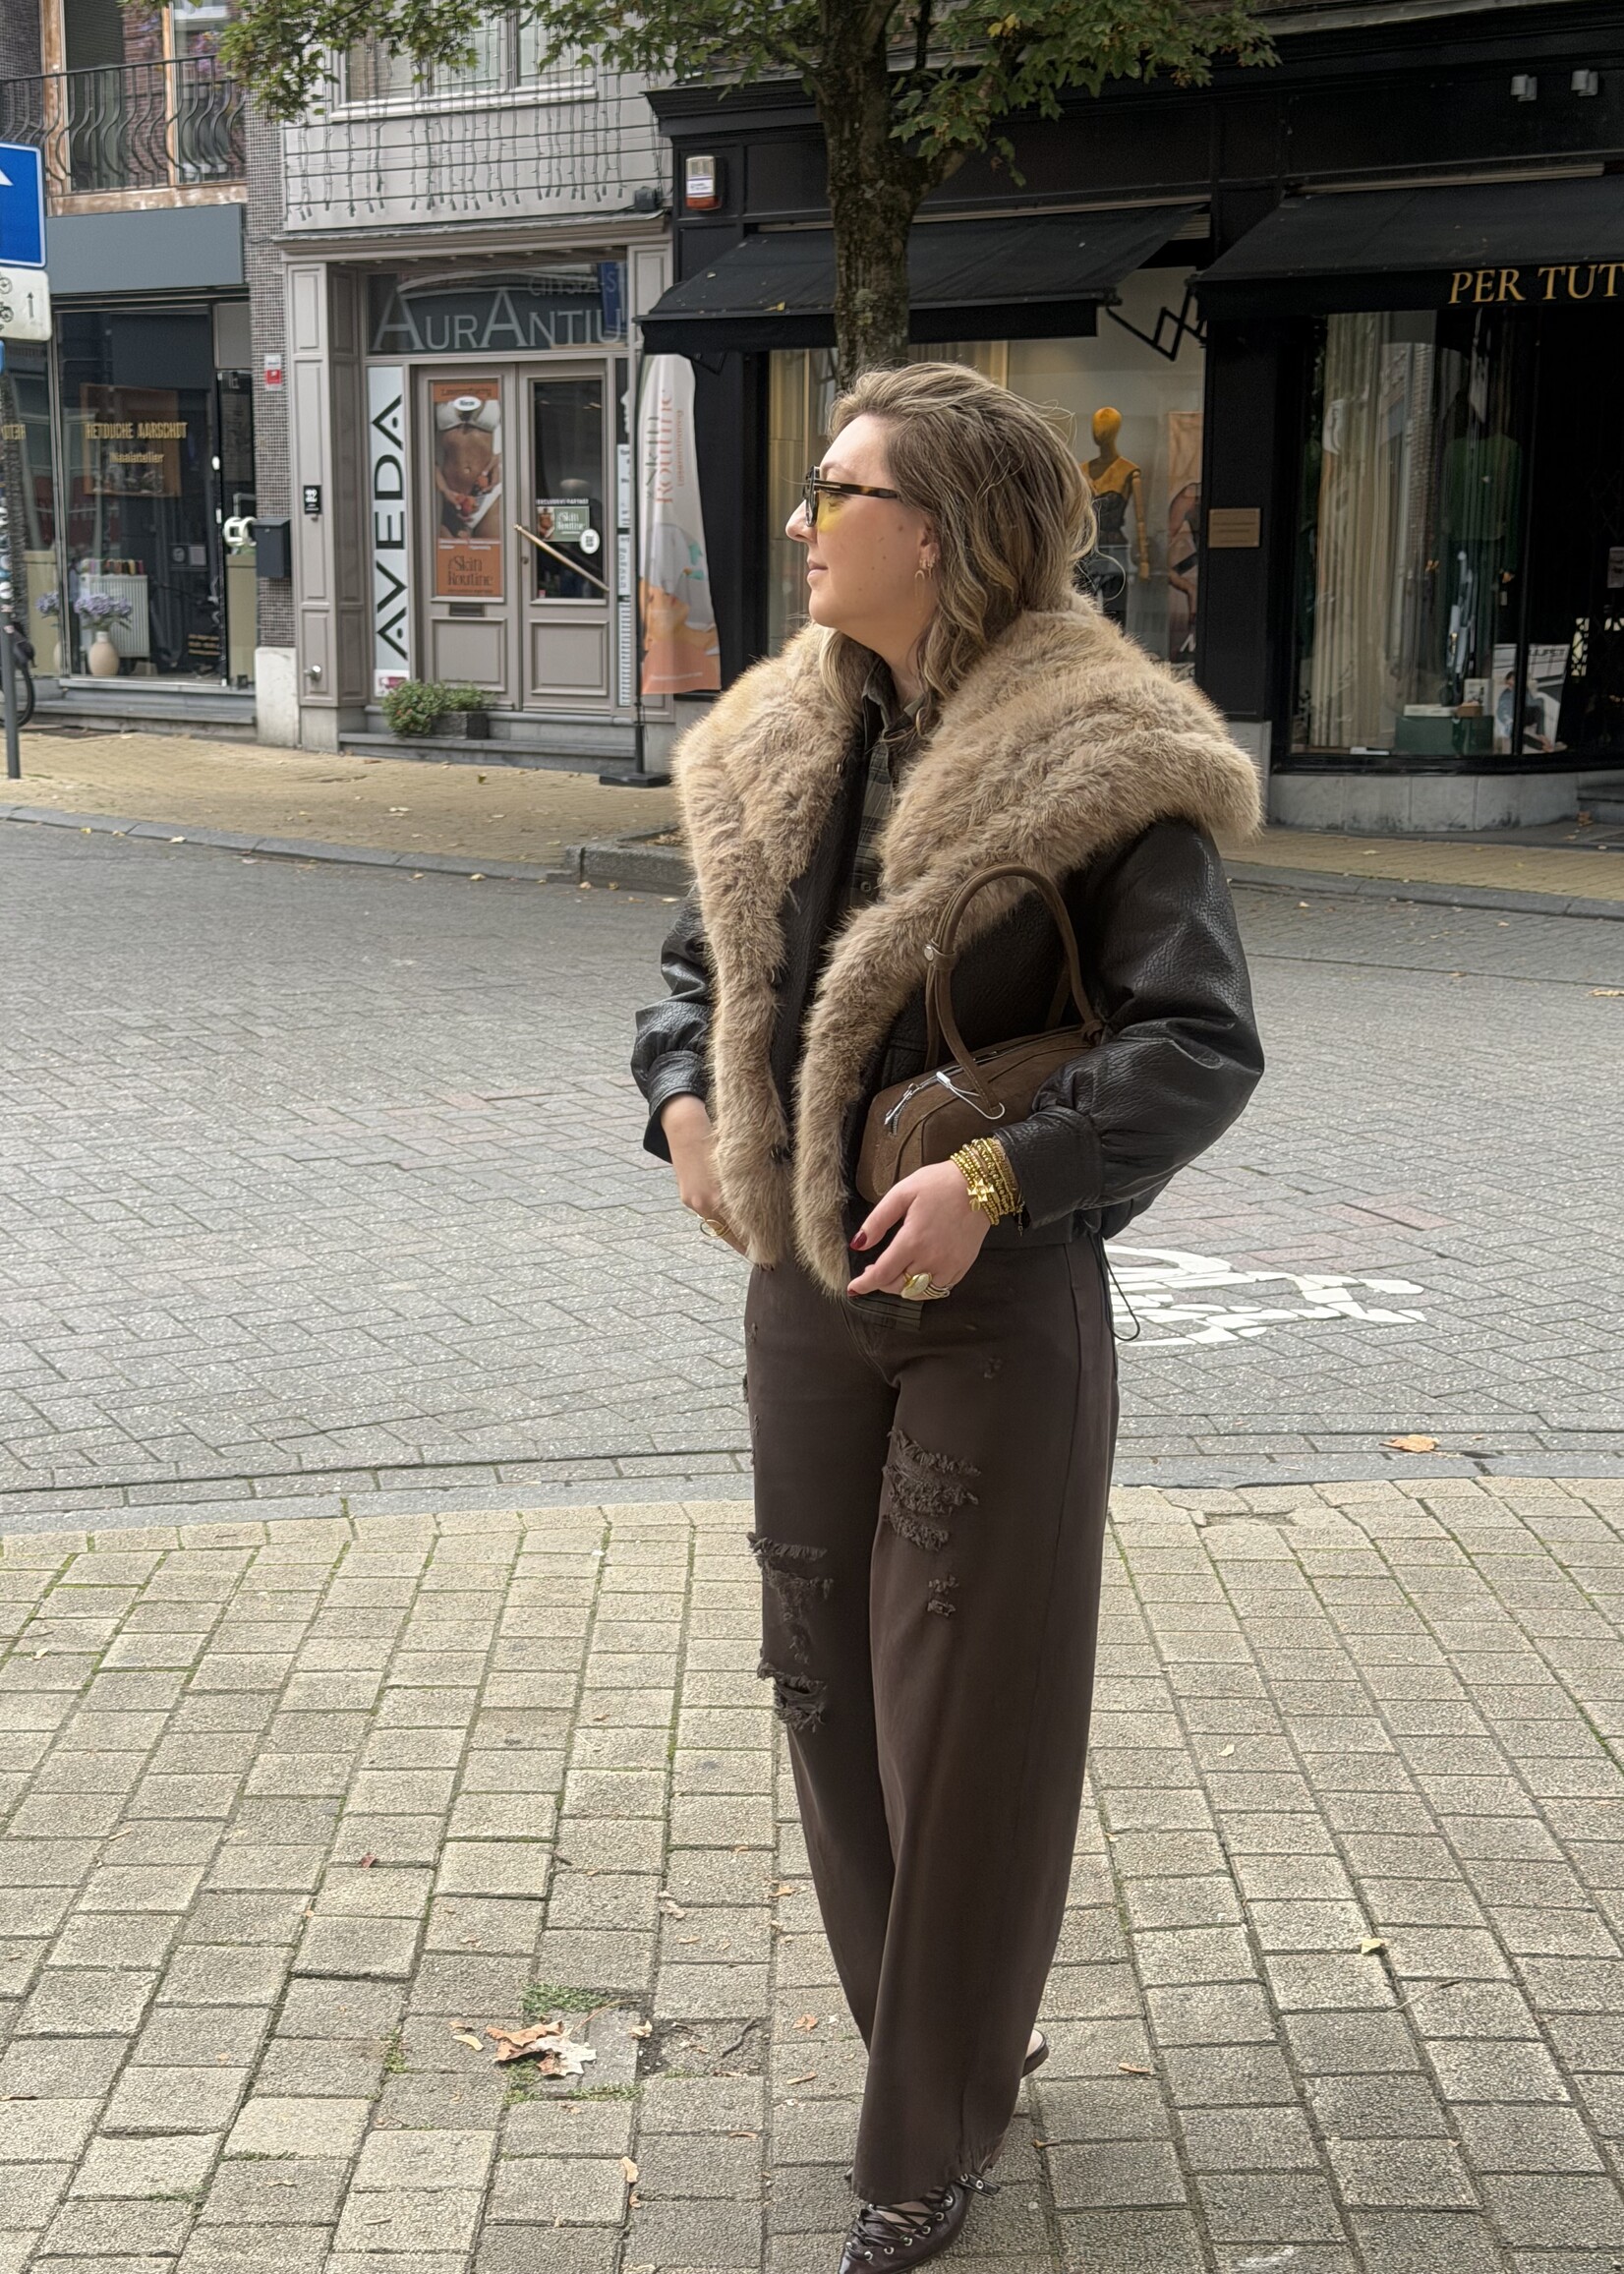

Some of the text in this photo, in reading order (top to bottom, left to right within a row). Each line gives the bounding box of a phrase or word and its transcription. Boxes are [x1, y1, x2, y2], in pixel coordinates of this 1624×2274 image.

[1447, 262, 1624, 304] PER TUT
[85, 421, 189, 439] RETOUCHE AARSCHOT
[655, 397, 673, 503] Routine
[372, 394, 408, 661] AVEDA
[447, 570, 493, 586] Routine
